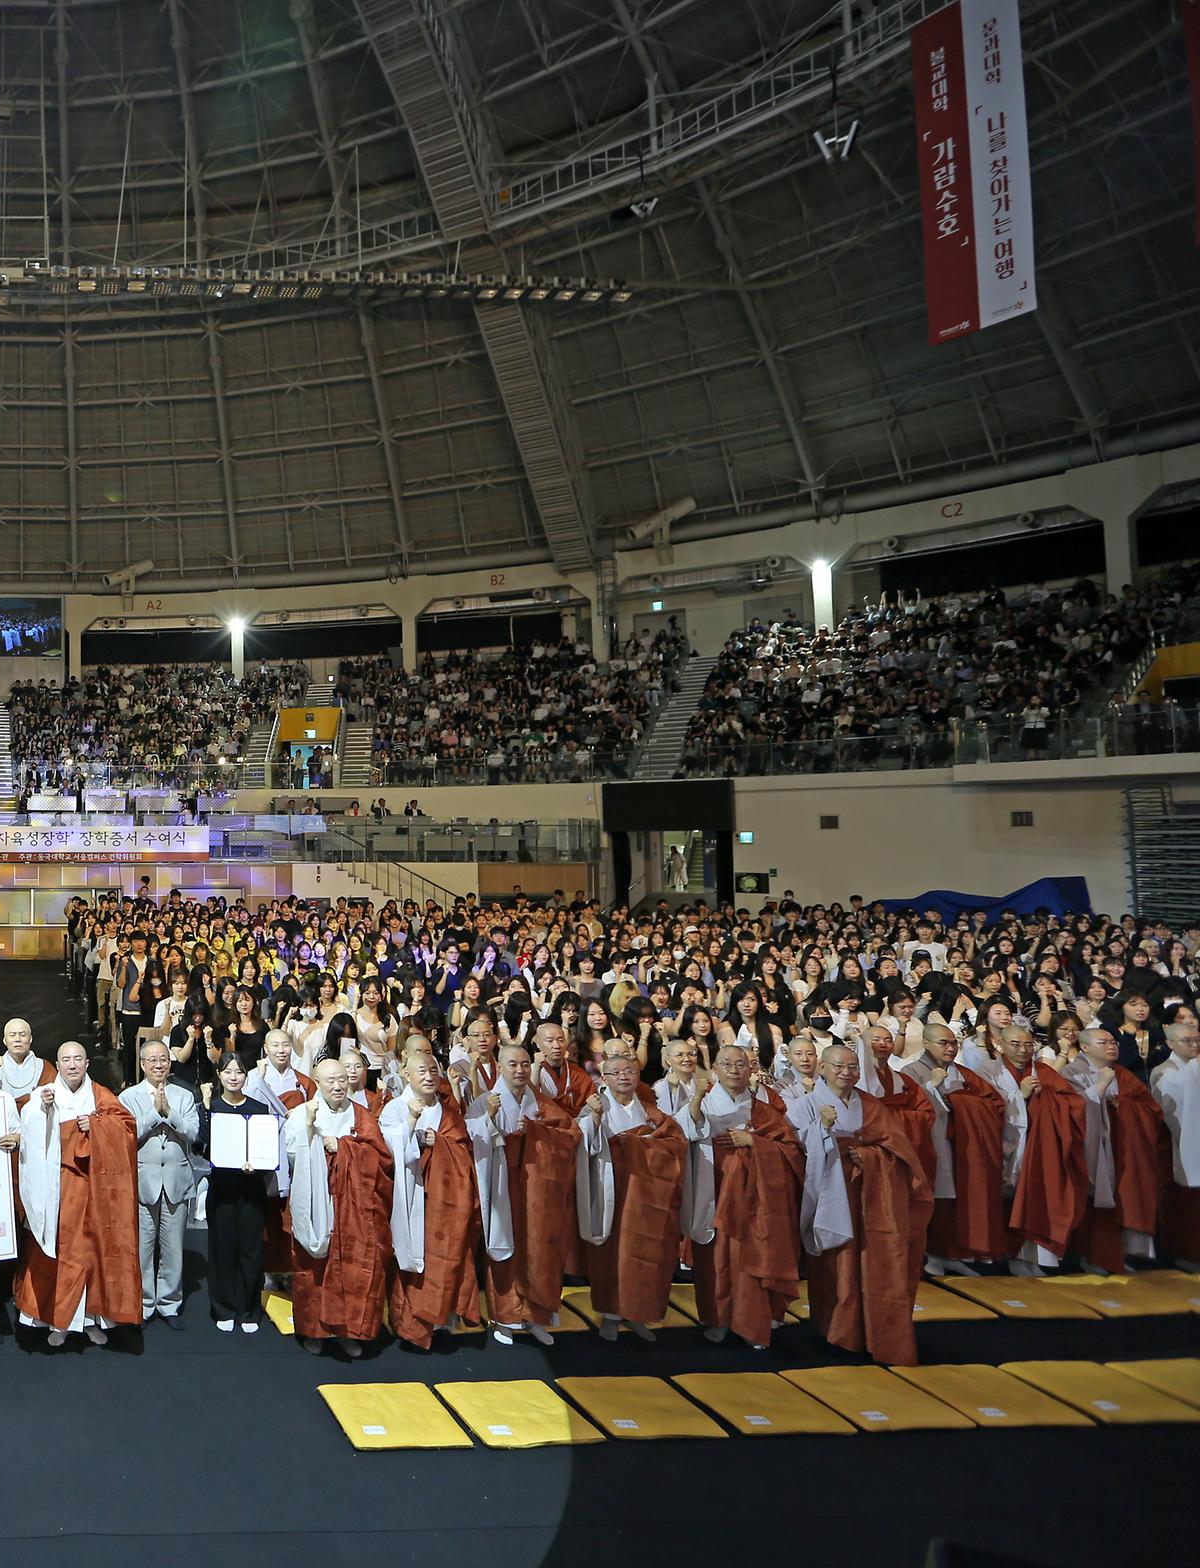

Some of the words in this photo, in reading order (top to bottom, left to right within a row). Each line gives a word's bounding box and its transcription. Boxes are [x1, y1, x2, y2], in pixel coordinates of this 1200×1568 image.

[982, 17, 1002, 84] 문과대학
[930, 46, 949, 113] 불교대학
[990, 155, 1013, 236] 찾아가는
[941, 502, 964, 518] C2
[490, 574, 505, 586] B2
[146, 599, 162, 610] A2
[79, 831, 139, 847] 장학증서
[142, 831, 187, 847] 수여식
